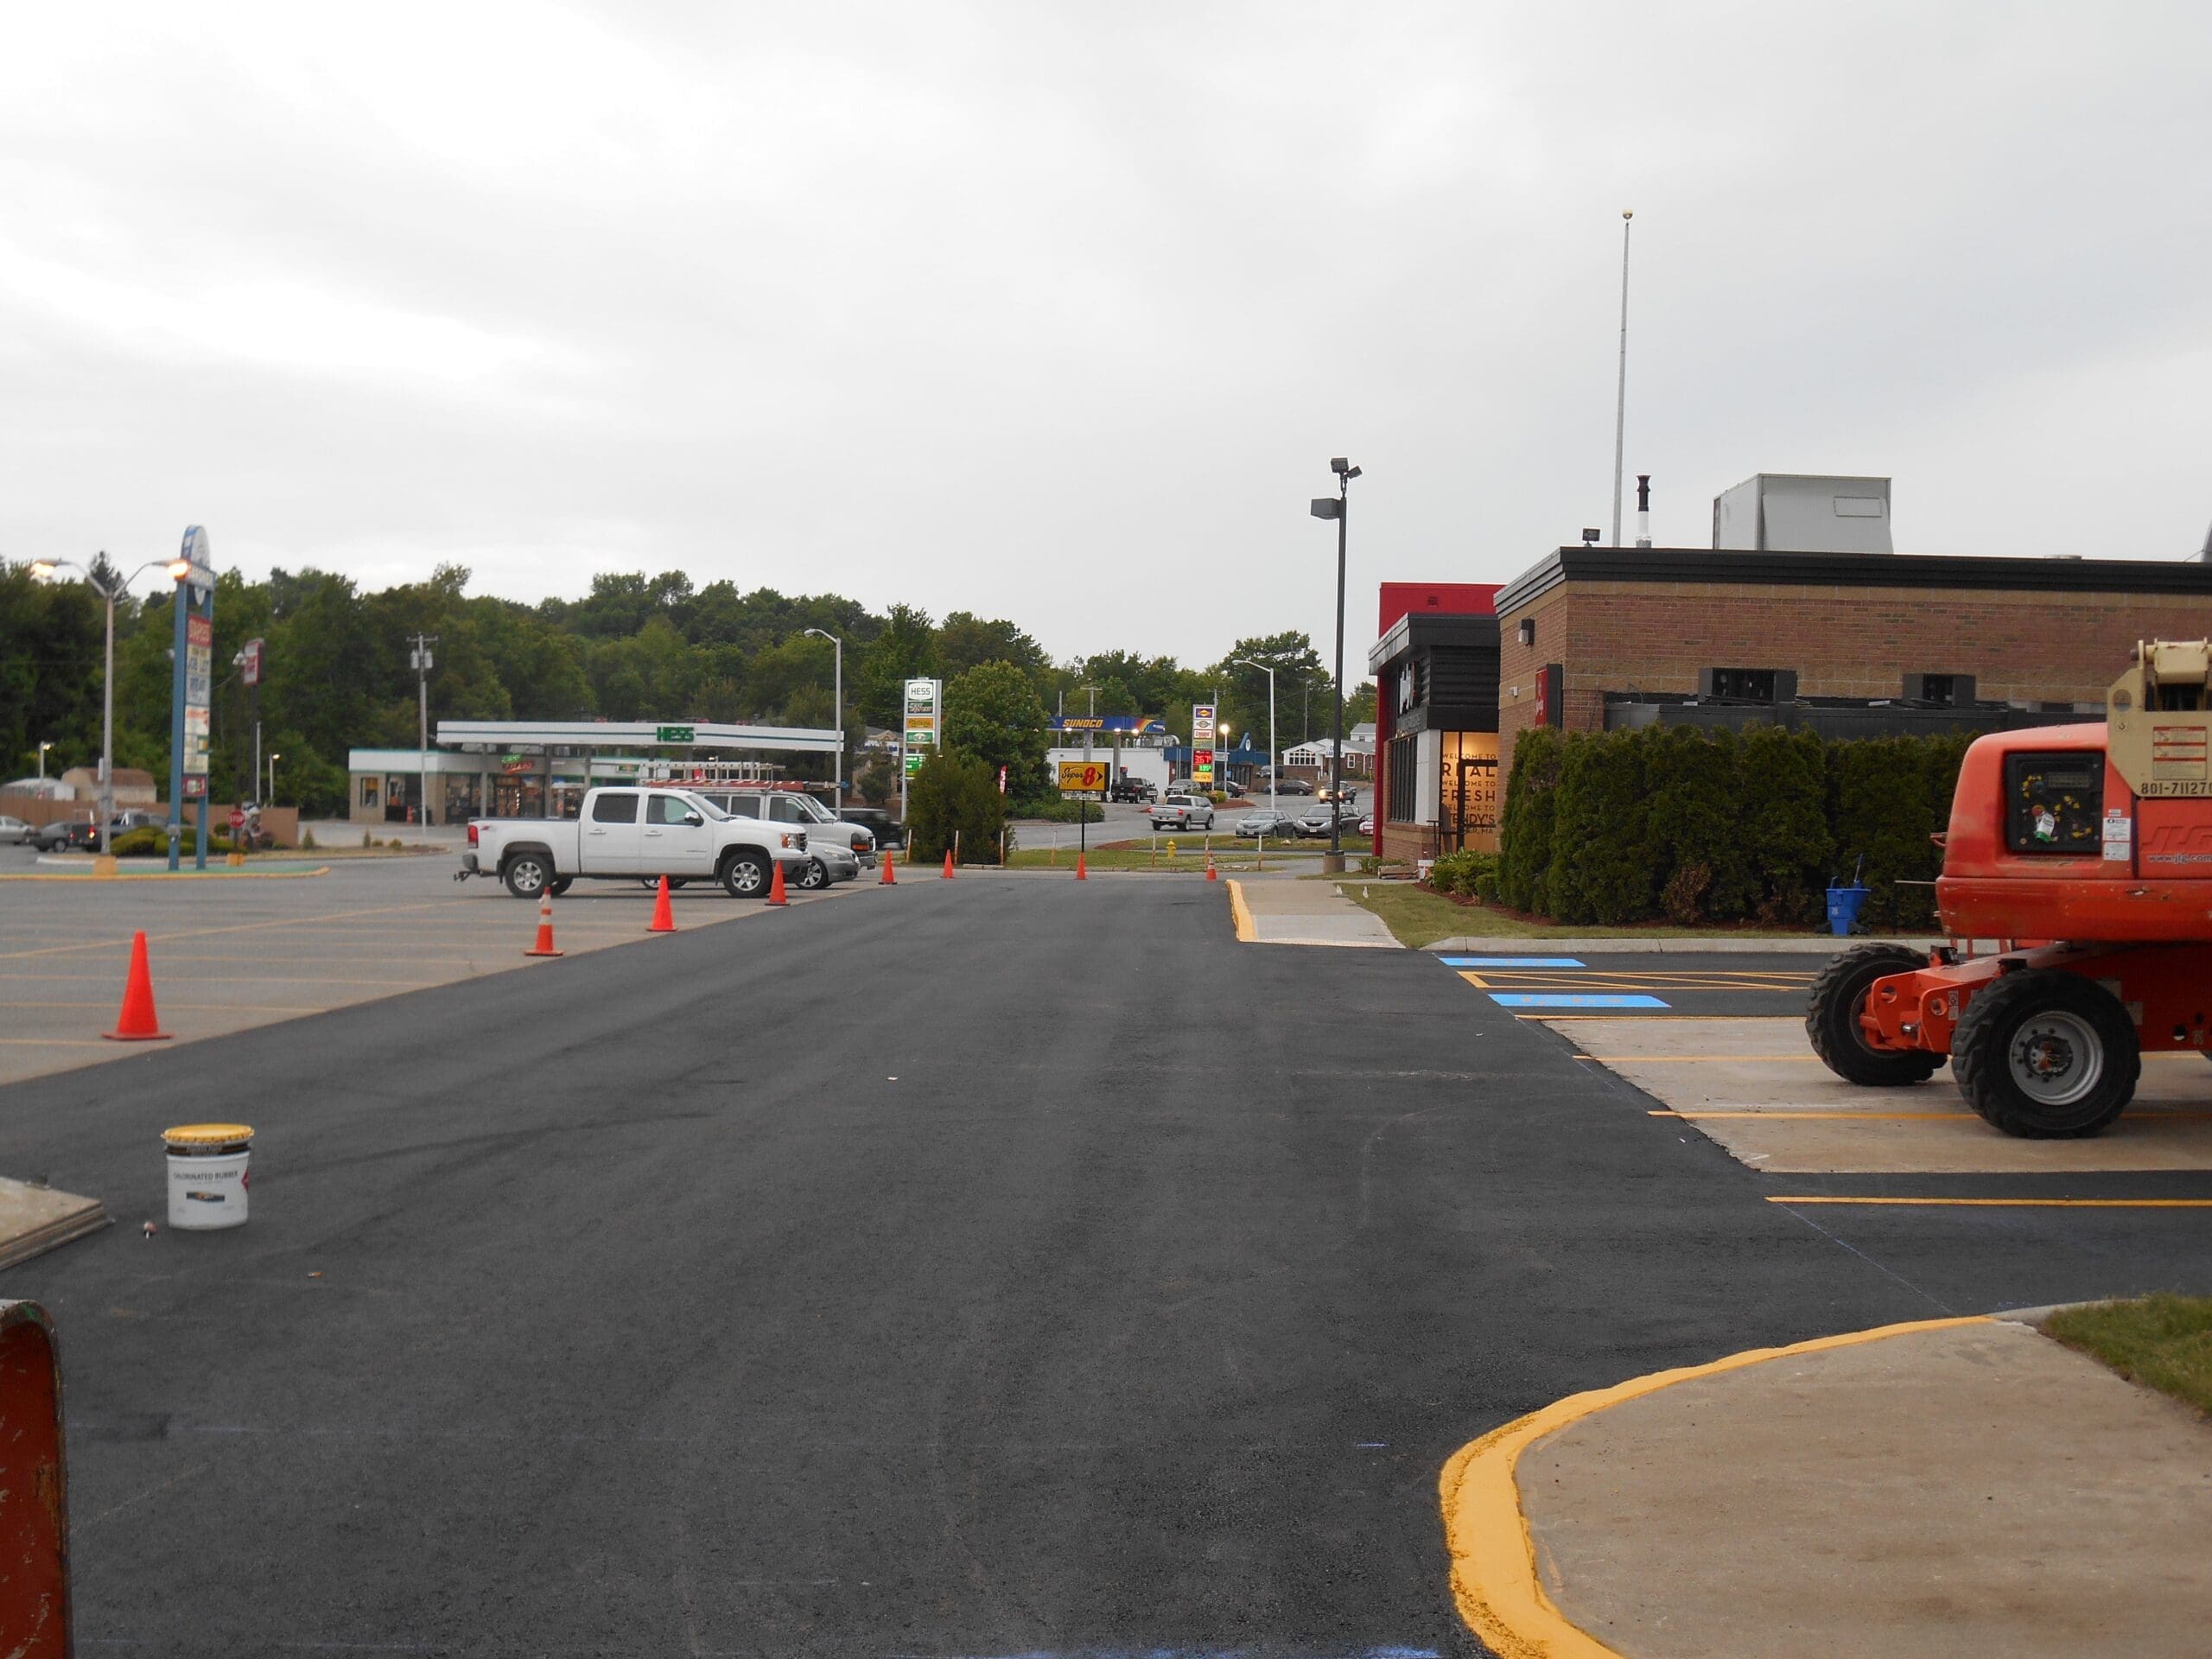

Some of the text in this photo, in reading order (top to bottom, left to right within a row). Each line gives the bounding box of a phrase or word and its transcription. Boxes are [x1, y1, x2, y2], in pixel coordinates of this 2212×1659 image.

[1063, 719, 1103, 728] SUNOCO
[657, 727, 694, 742] HESS
[1061, 766, 1096, 786] Super 8
